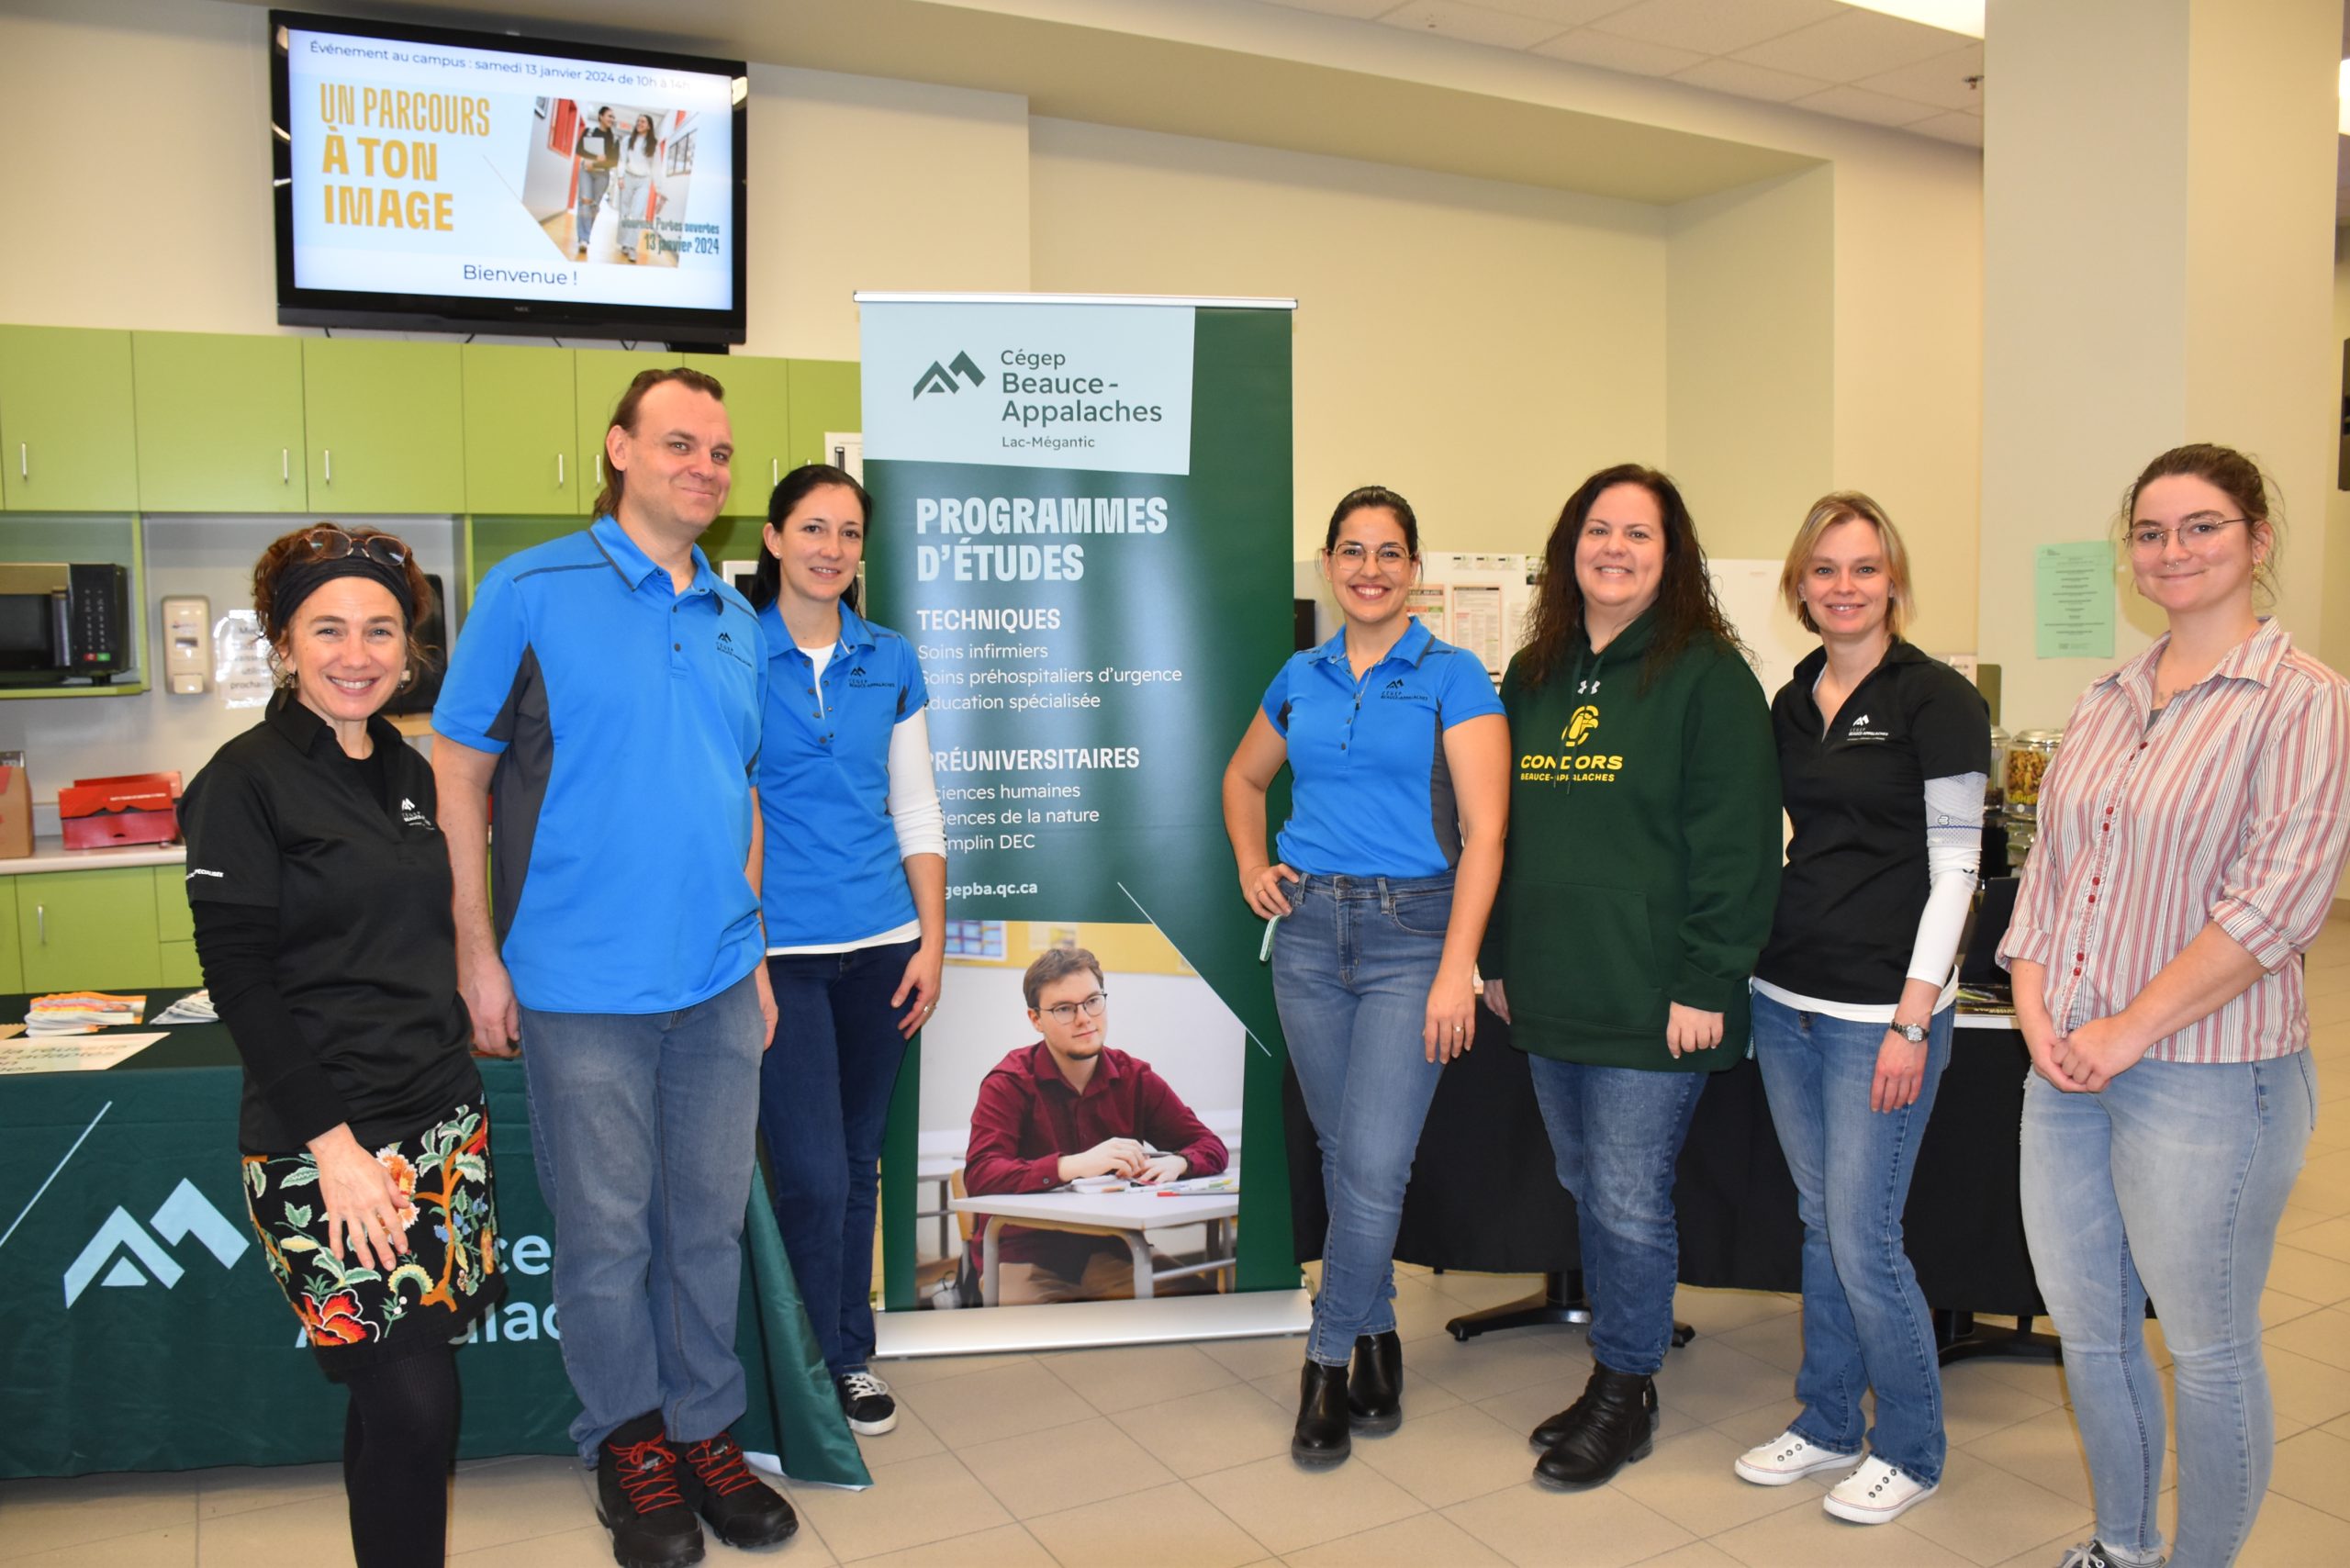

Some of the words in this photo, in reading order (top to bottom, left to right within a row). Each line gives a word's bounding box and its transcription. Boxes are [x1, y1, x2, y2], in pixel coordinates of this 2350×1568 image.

[309, 40, 389, 60] Événement
[392, 51, 409, 62] au
[412, 53, 466, 68] campus
[475, 61, 522, 73] samedi
[525, 64, 537, 75] 13
[540, 65, 582, 79] janvier
[585, 70, 615, 83] 2024
[618, 73, 633, 84] de
[320, 83, 355, 126] UN
[364, 87, 490, 138] PARCOURS
[322, 125, 350, 175] À
[356, 136, 438, 182] TON
[324, 184, 454, 231] IMAGE
[644, 233, 656, 251] 13
[658, 236, 693, 255] janvier
[694, 237, 720, 255] 2024
[463, 263, 567, 286] Bienvenue
[1001, 349, 1067, 370] Cégep
[1002, 399, 1162, 428] Appalaches
[1002, 435, 1095, 451] Lac-Mégantic
[916, 497, 1168, 534] PROGRAMMES
[917, 537, 1085, 581] D'ÉTUDES
[916, 608, 1061, 634] TECHNIQUES
[918, 644, 964, 660] Soins
[969, 644, 1048, 659] infirmiers
[923, 670, 964, 685] Soins
[969, 667, 1093, 688] préhospitaliers
[1099, 667, 1182, 686] d'urgence
[1009, 692, 1102, 712] spécialisée
[935, 785, 995, 800] ciences
[1001, 783, 1080, 800] humaines
[943, 811, 996, 825] iences
[1001, 810, 1023, 823] de
[1027, 809, 1041, 823] la
[1046, 810, 1100, 823] nature
[946, 834, 994, 854] mplin
[1000, 834, 1035, 849] DEC
[946, 882, 1038, 900] gepba.qc.ca
